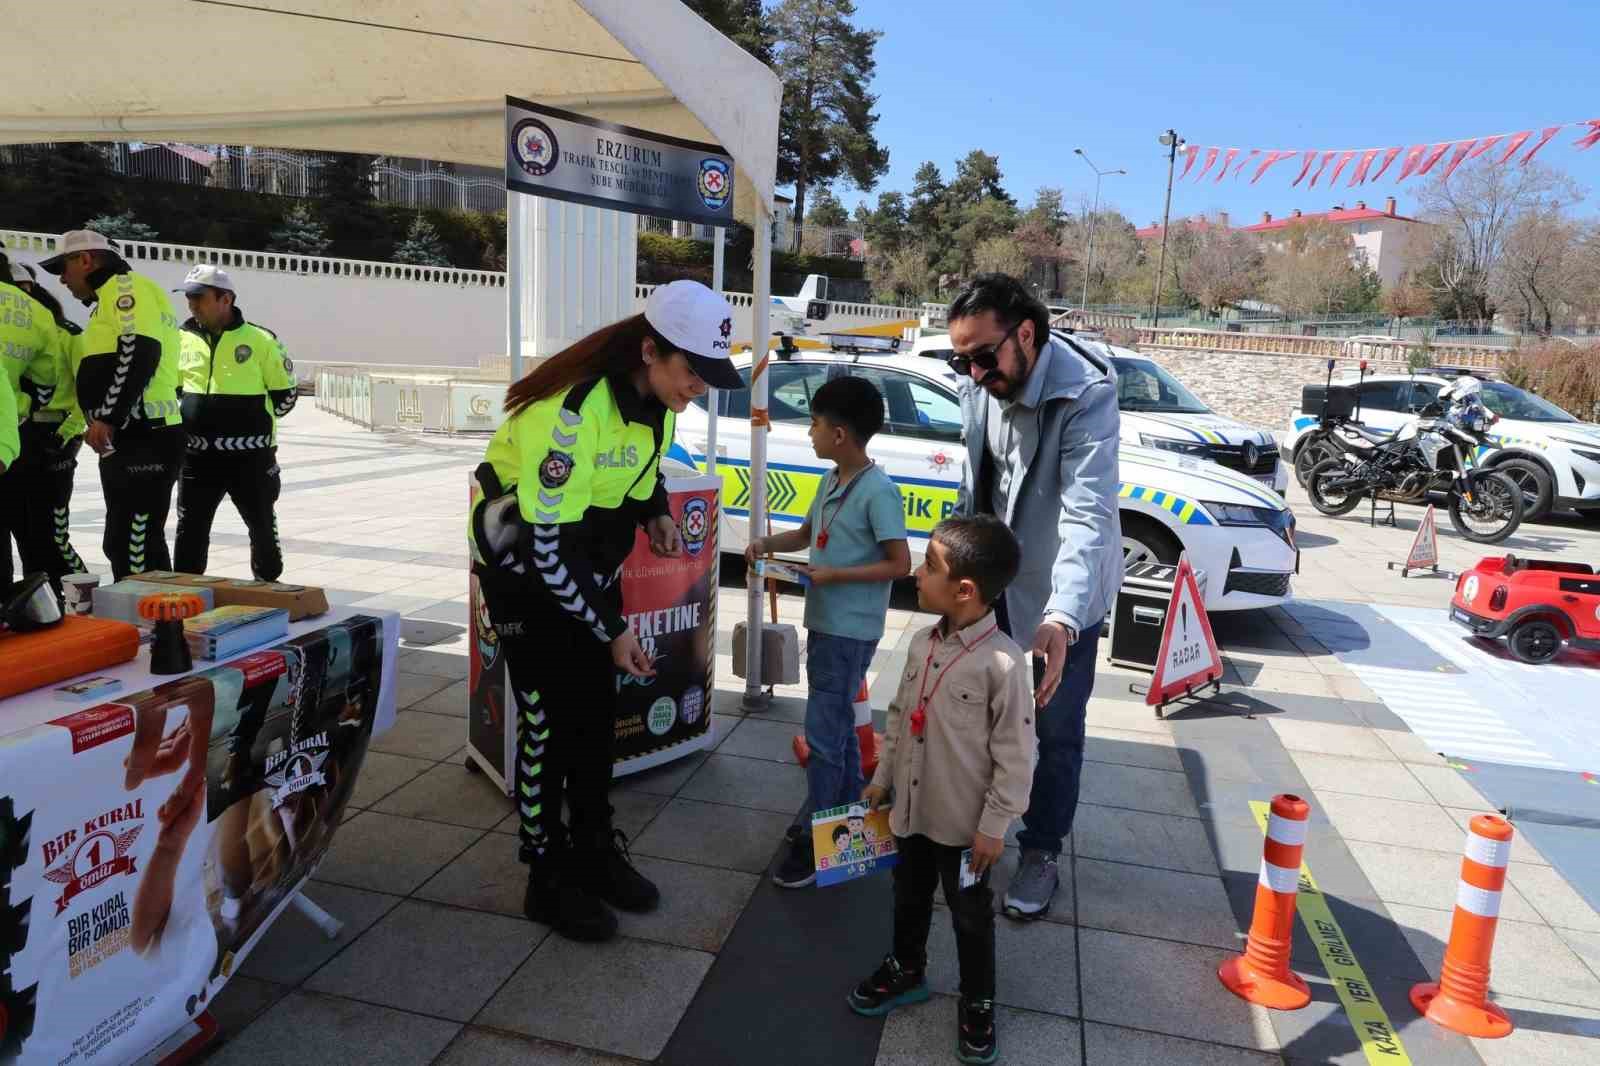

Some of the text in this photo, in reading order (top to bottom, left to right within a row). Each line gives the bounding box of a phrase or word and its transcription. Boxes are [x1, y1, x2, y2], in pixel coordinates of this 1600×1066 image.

[596, 138, 661, 168] ERZURUM
[1173, 642, 1200, 672] RADAR
[265, 749, 288, 775] BİR
[291, 759, 304, 777] 1
[42, 798, 144, 868] BİR KURAL
[86, 841, 101, 868] 1
[92, 891, 128, 925] KURAL
[1313, 919, 1400, 1056] KAZA YERİ GİRİLMEZ
